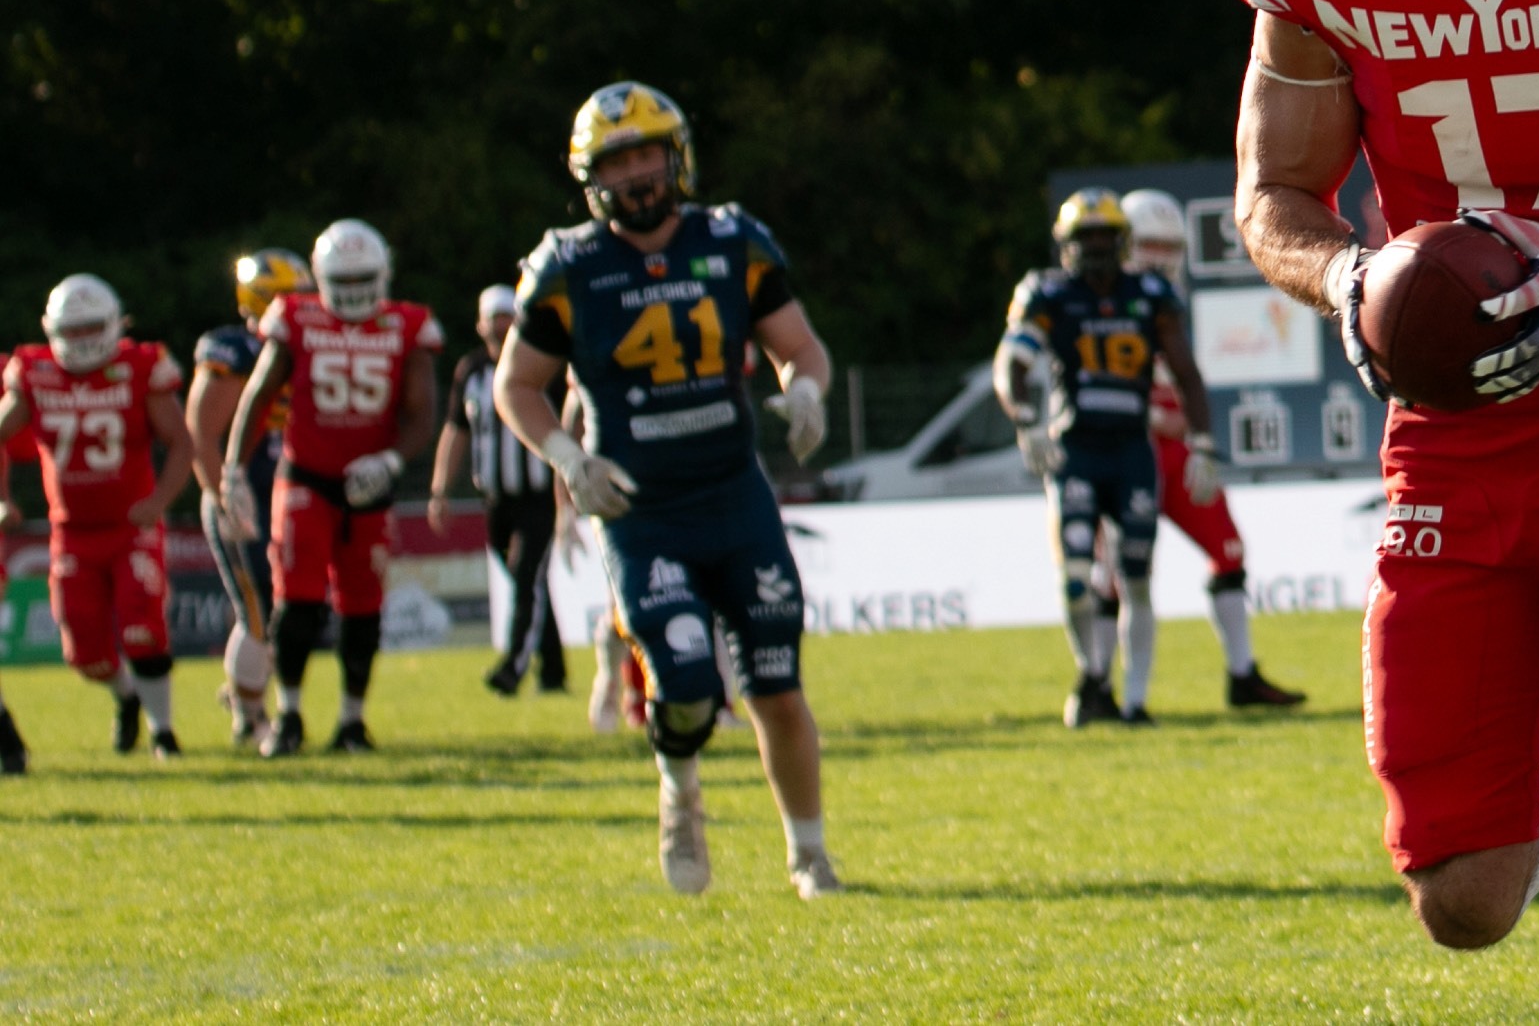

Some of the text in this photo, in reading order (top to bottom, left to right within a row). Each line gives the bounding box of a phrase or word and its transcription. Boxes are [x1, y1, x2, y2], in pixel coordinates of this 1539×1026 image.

[620, 280, 705, 309] HILDESHEIM
[611, 296, 725, 385] 41
[310, 353, 392, 414] 55
[41, 411, 126, 471] 73
